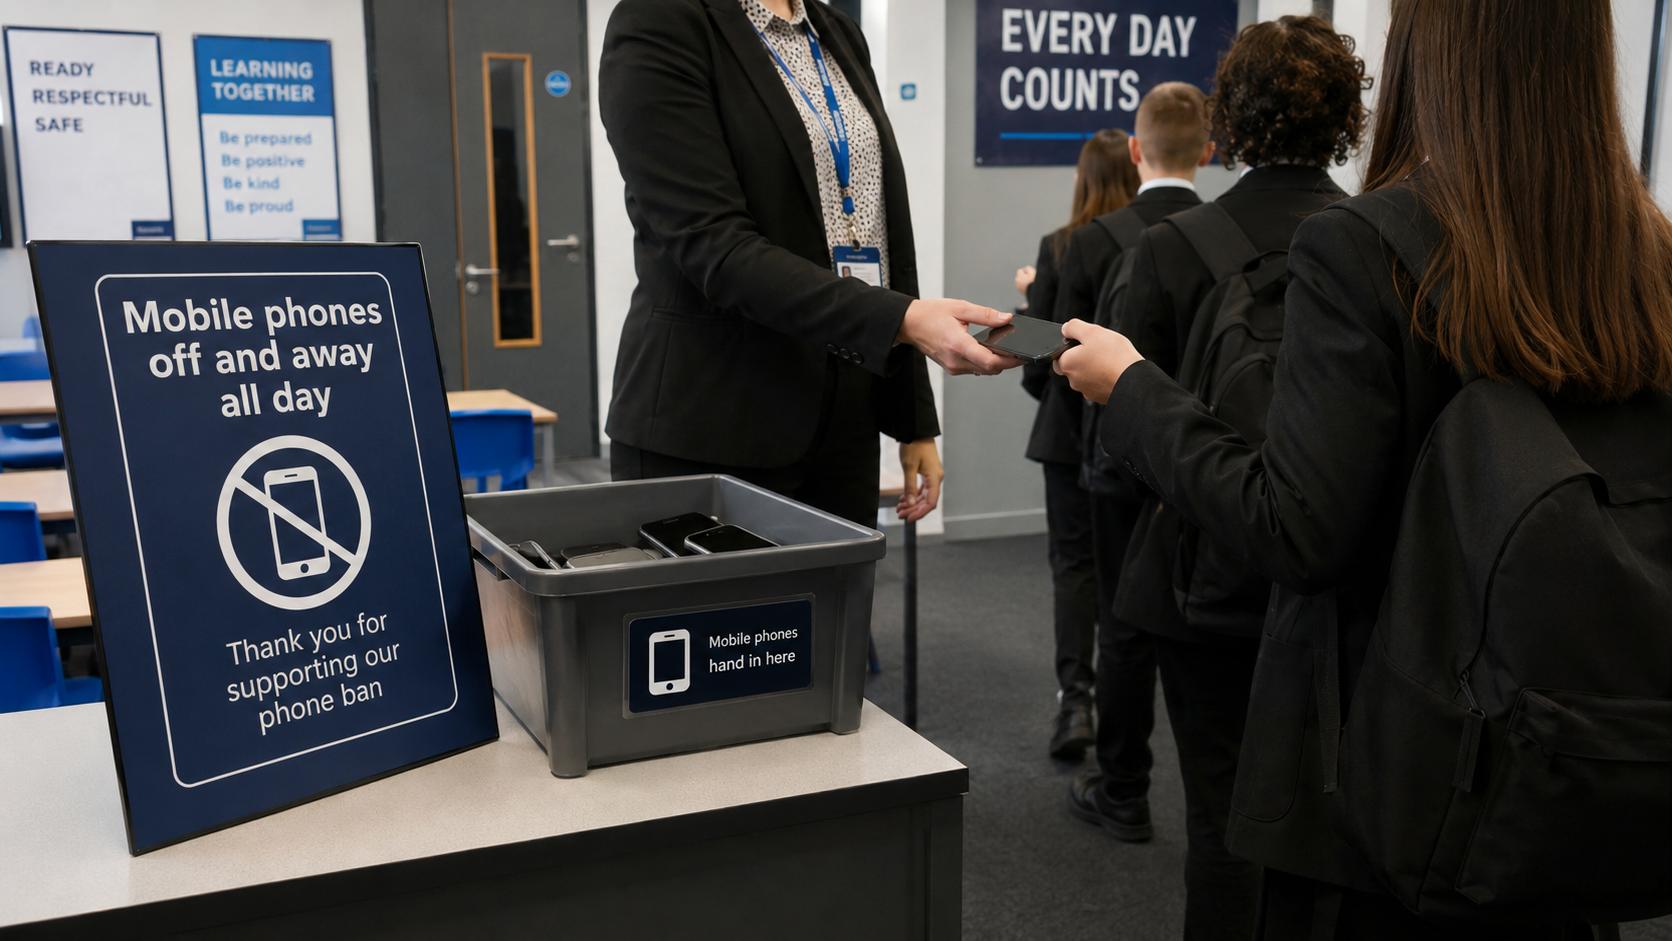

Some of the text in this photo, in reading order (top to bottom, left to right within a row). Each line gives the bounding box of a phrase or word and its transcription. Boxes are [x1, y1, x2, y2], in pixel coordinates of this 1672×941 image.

[1001, 8, 1197, 58] EVERY DAY
[30, 61, 94, 77] READY
[210, 59, 314, 80] LEARNING
[33, 90, 153, 107] RESPECTFUL
[211, 82, 315, 103] TOGETHER
[1000, 66, 1140, 112] COUNTS
[35, 117, 84, 133] SAFE
[219, 131, 313, 149] Be prepared
[221, 154, 305, 170] Be positive
[223, 177, 280, 191] Be kind
[225, 200, 294, 215] Be proud
[122, 296, 383, 336] Mobile phones
[148, 339, 374, 379] off and away
[220, 380, 332, 418] all day
[225, 612, 388, 666] Thank you for
[709, 628, 798, 649] Mobile phones
[227, 641, 401, 702] supporting our
[709, 651, 796, 673] hand in here
[258, 679, 383, 736] phone ban
